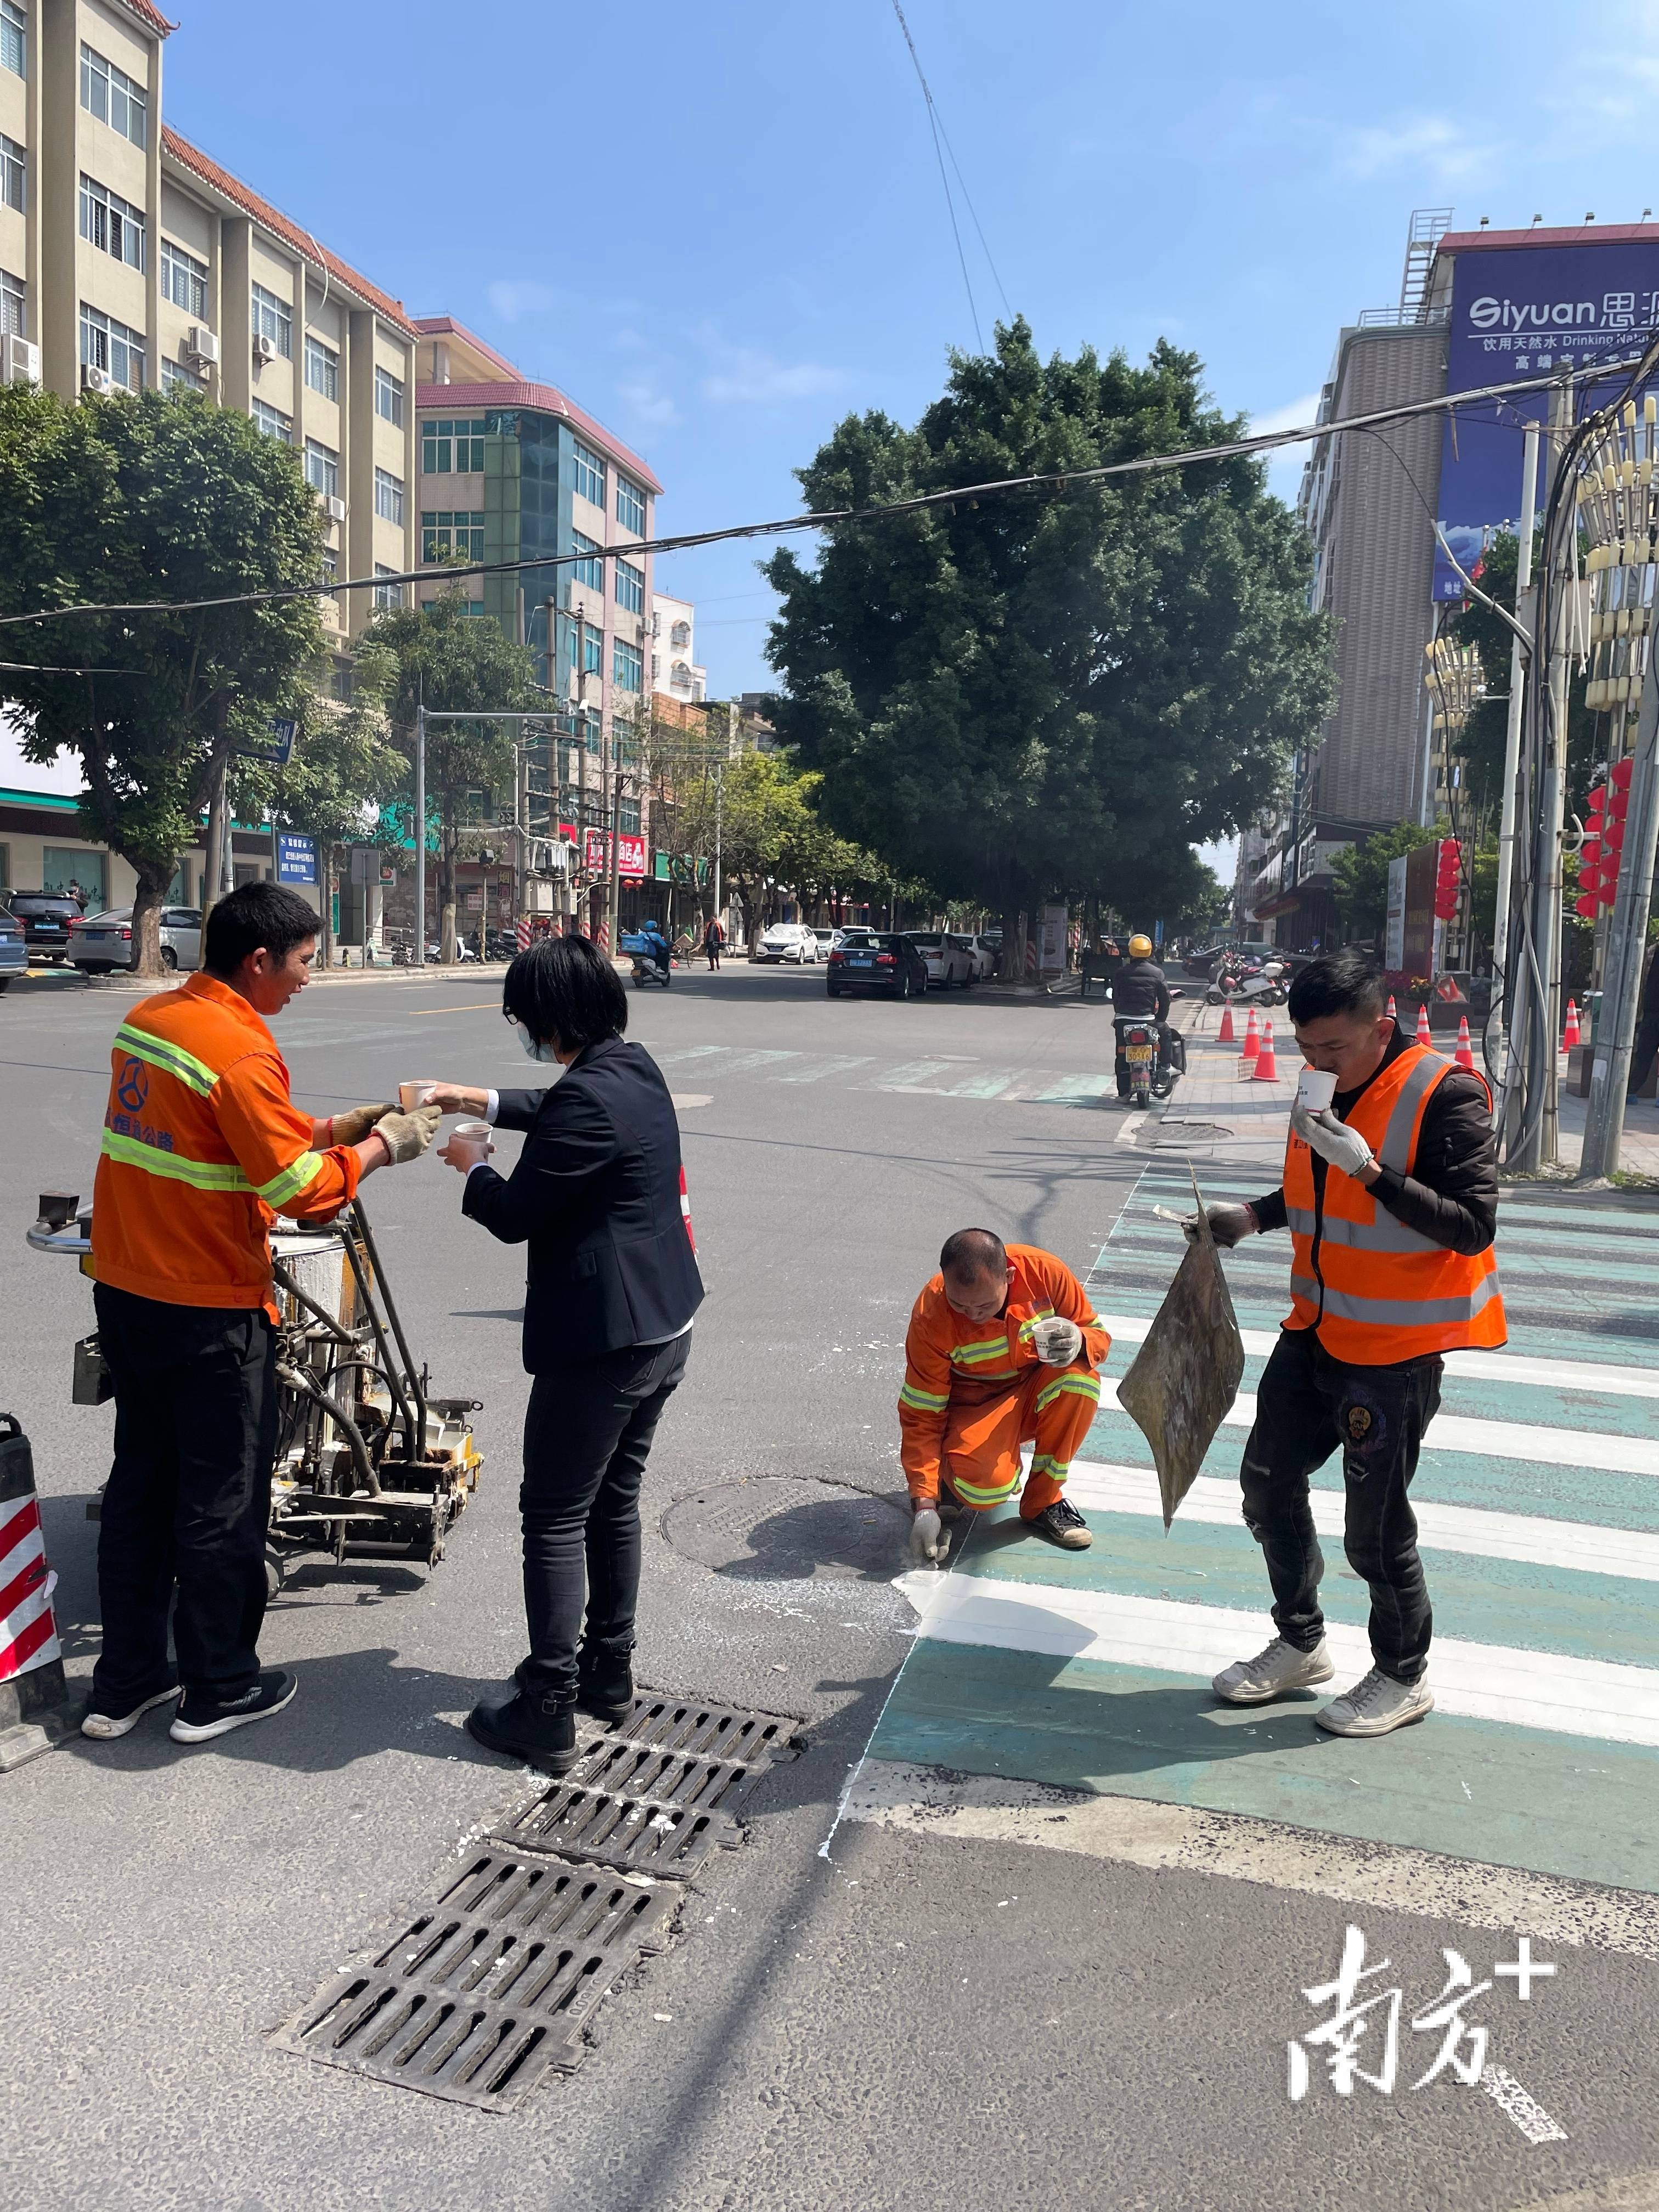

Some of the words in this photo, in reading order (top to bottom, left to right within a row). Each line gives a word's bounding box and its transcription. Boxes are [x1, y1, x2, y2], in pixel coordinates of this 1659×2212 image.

[1469, 297, 1595, 332] Siyuan
[1483, 335, 1557, 352] 饮用天然水
[1563, 335, 1613, 347] Drinking
